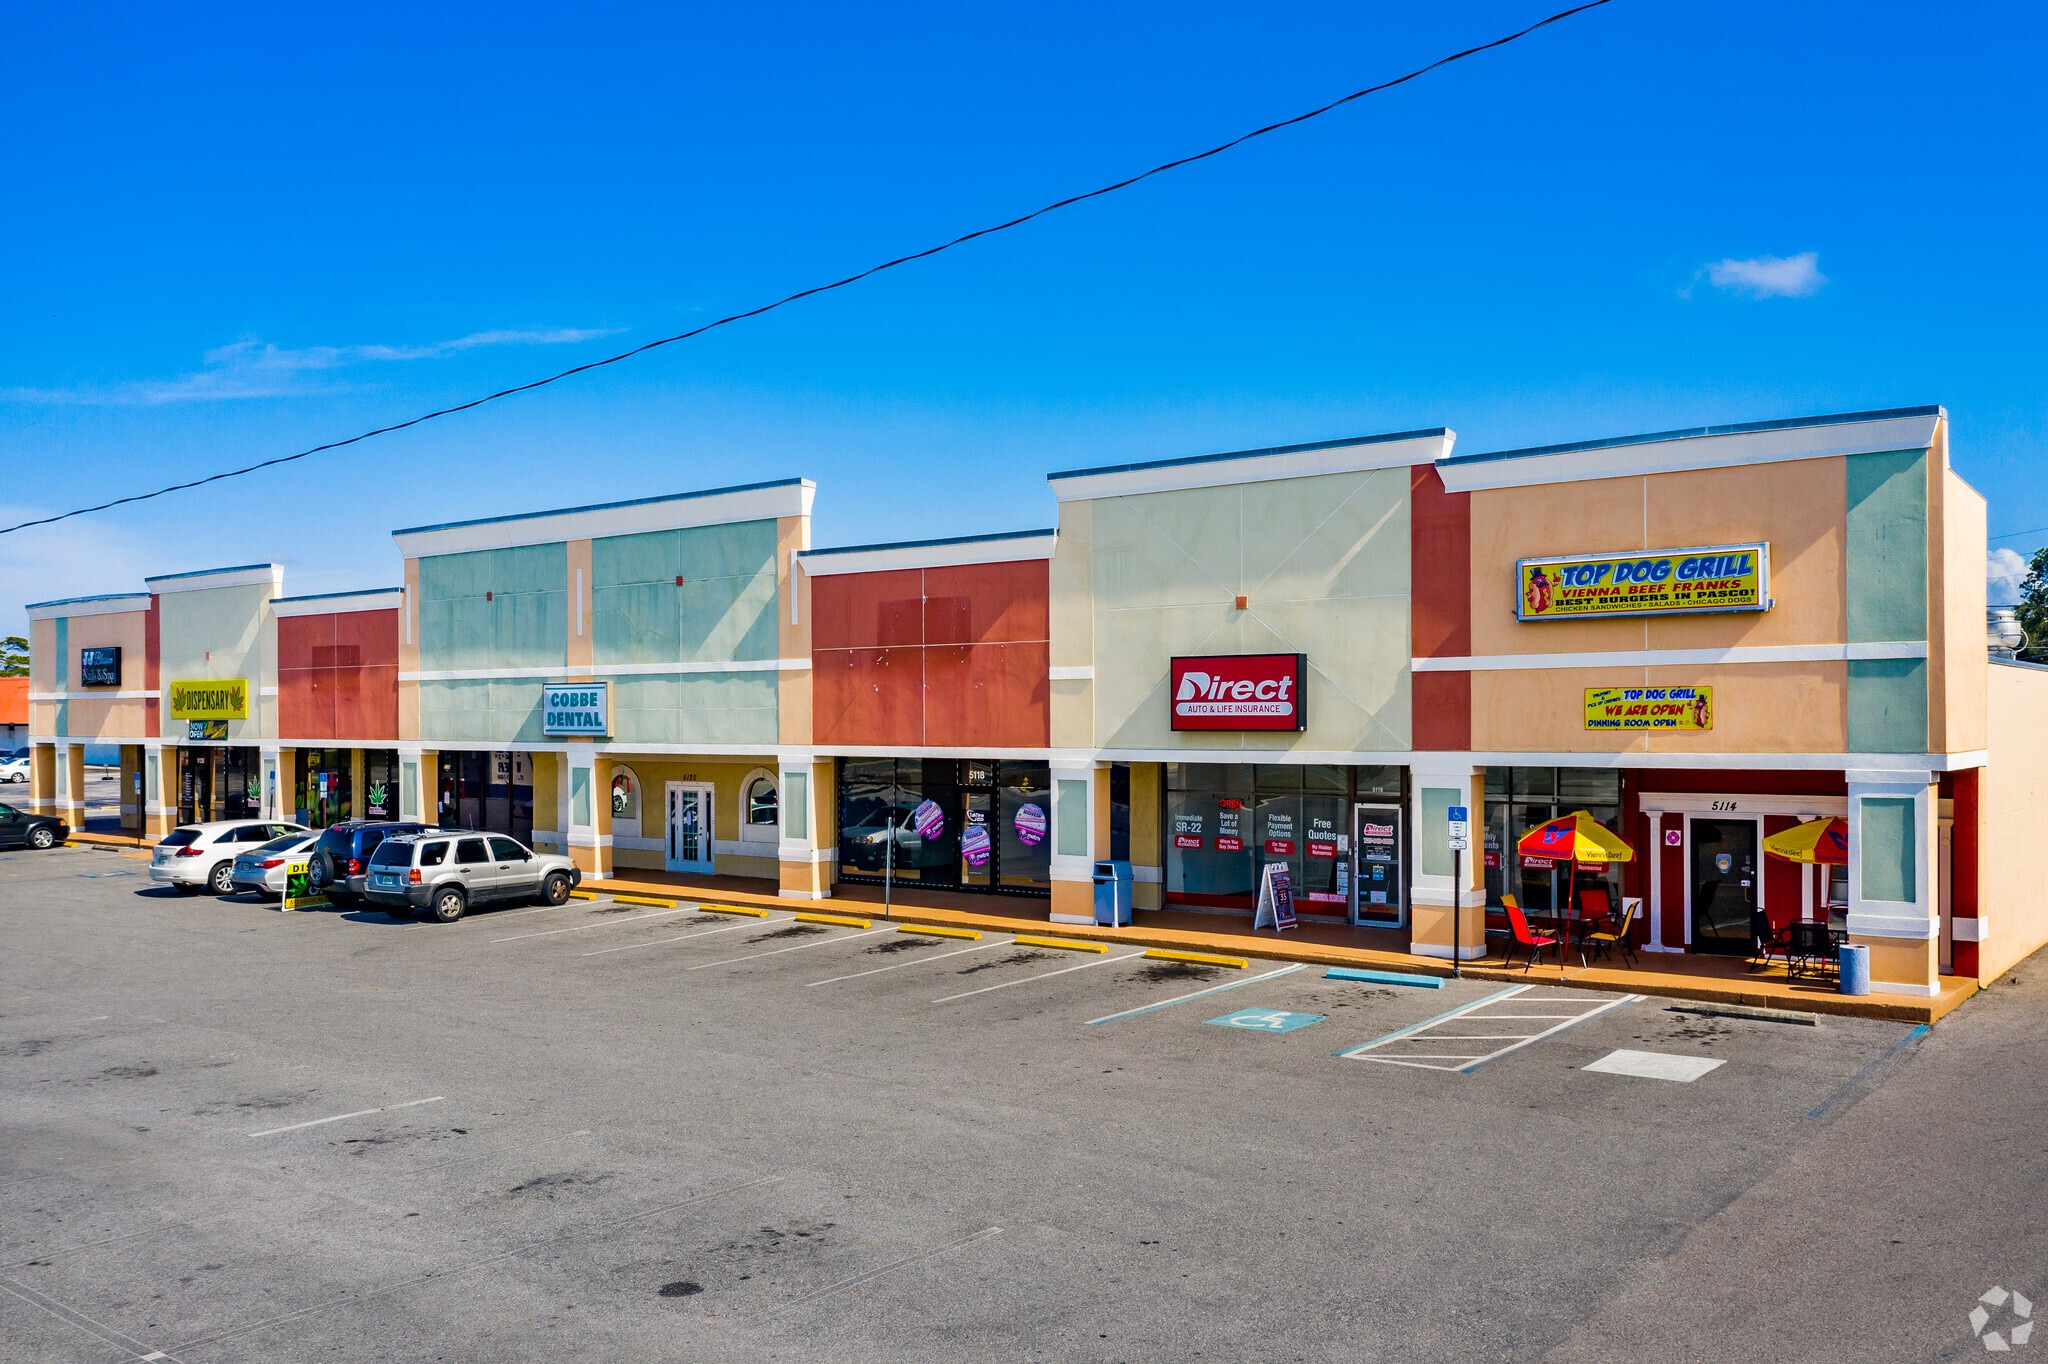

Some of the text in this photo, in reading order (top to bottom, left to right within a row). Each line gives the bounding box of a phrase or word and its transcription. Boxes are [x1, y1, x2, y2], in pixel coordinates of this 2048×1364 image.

[1561, 554, 1753, 588] TOP DOG GRILL
[1562, 580, 1742, 598] VIENNA BEEF FRANKS
[1555, 589, 1755, 606] BEST BURGERS IN PASCO!
[1590, 602, 1642, 611] SANDWICHES
[1648, 600, 1680, 608] SALADS
[1687, 598, 1726, 606] CHICAGO
[1728, 596, 1752, 604] DOGS
[83, 652, 94, 665] JJ
[1176, 672, 1292, 700] Direct
[1623, 688, 1696, 701] TOP DOG GRILL
[187, 690, 230, 710] DISPENSARY
[551, 693, 597, 707] COBBE
[1605, 704, 1685, 716] WE ARE OPEN
[547, 712, 602, 726] DENTAL
[1588, 719, 1620, 727] DINNING
[1624, 719, 1650, 727] ROOM
[191, 722, 203, 730] NOW
[969, 771, 985, 779] 5118
[1219, 798, 1242, 808] OPEN
[1712, 801, 1737, 811] 5114
[1269, 814, 1291, 822] Flexible
[1314, 818, 1331, 828] Free
[1176, 822, 1201, 832] SR-22
[1268, 822, 1293, 830] Payment
[1220, 828, 1238, 836] Money
[1269, 830, 1291, 838] Options
[1308, 830, 1337, 840] Quotes
